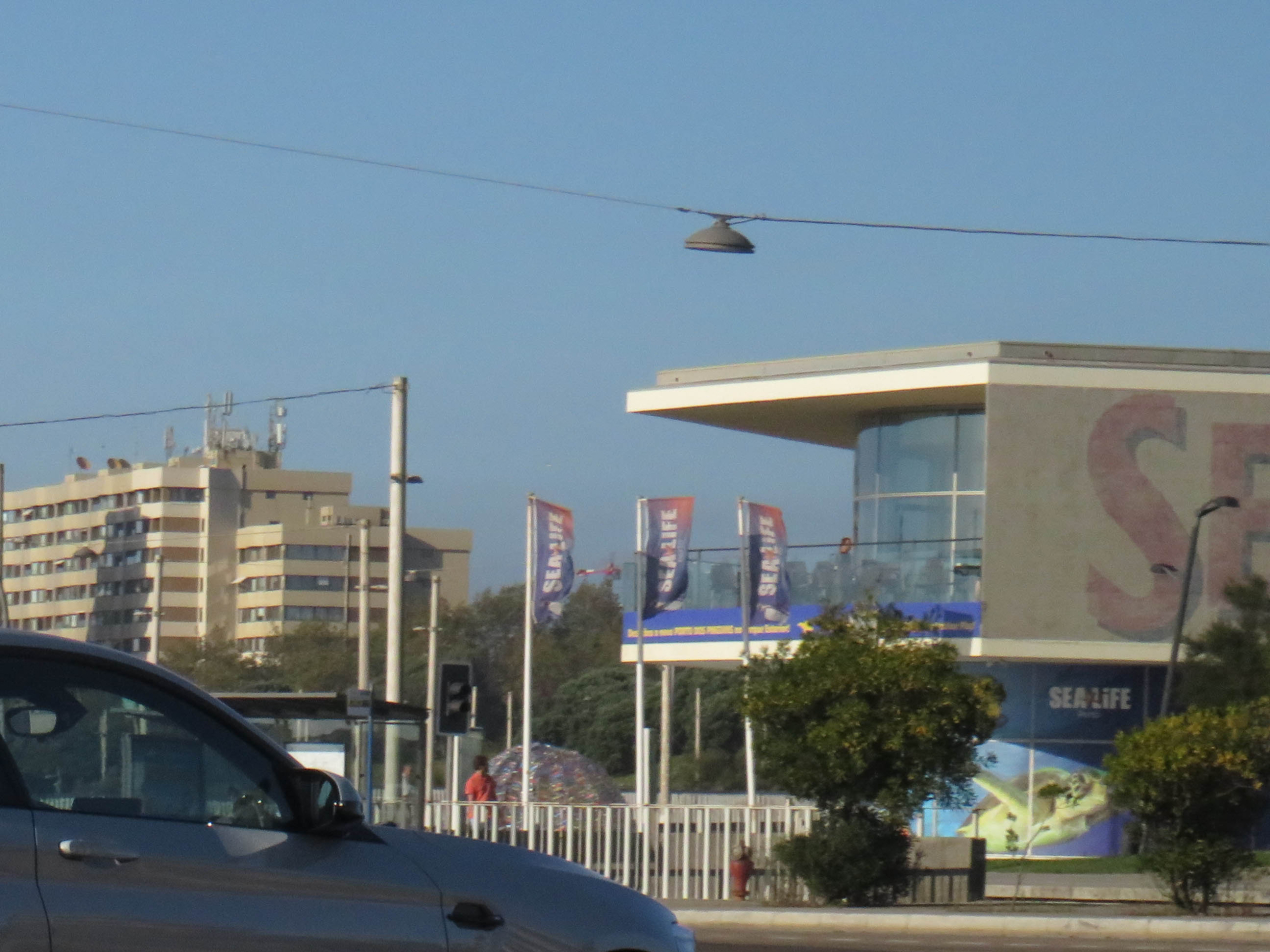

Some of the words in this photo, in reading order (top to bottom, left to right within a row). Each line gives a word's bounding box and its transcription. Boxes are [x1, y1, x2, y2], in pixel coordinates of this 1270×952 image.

[661, 508, 678, 549] LIFE
[759, 515, 779, 554] LIFE
[542, 555, 564, 593] SEA
[658, 554, 677, 593] SEA
[758, 559, 780, 597] SEA
[1048, 686, 1088, 709] SEA
